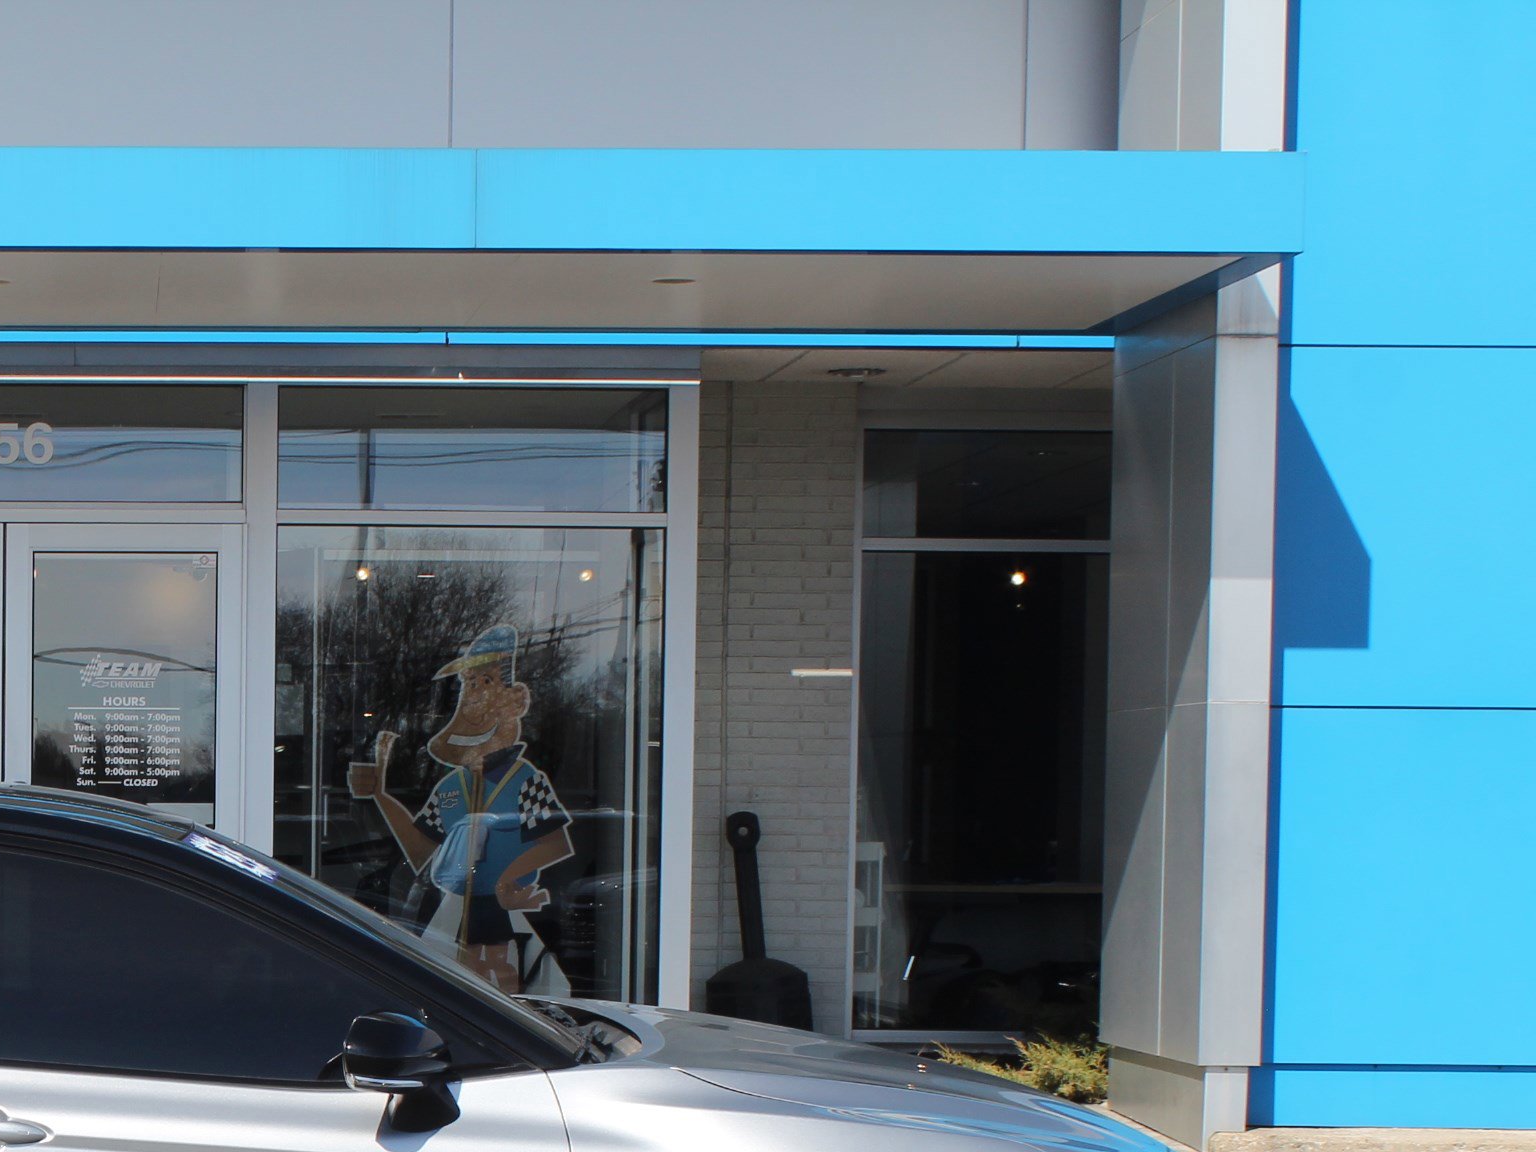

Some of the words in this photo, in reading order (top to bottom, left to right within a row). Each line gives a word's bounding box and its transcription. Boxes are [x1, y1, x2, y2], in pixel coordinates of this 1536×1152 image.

[96, 662, 162, 677] TEAM
[110, 680, 155, 689] CHEVROLET
[102, 696, 146, 707] HOURS
[73, 713, 96, 721] Mon.
[104, 713, 139, 722] 9:00am
[147, 714, 181, 723] 7:00pm
[74, 723, 96, 732] Tues.
[104, 723, 139, 732] 9:00am
[147, 724, 181, 734] 7:00pm
[73, 734, 96, 743] Wed.
[104, 734, 139, 743] 9:00am
[147, 735, 181, 745] 7:00pm
[69, 745, 96, 754] Thurs.
[104, 745, 139, 755] 9:00am
[147, 746, 181, 756] 7:00pm
[82, 756, 96, 764] Fri.
[104, 756, 139, 765] 9:00am
[146, 757, 181, 766] 6:00pm
[79, 767, 96, 775] Sat.
[104, 767, 139, 776] 9:00am
[146, 768, 181, 777] 5:00pm
[76, 778, 96, 786] Sun.
[123, 778, 158, 787] CLOSED
[439, 789, 459, 800] TEAM
